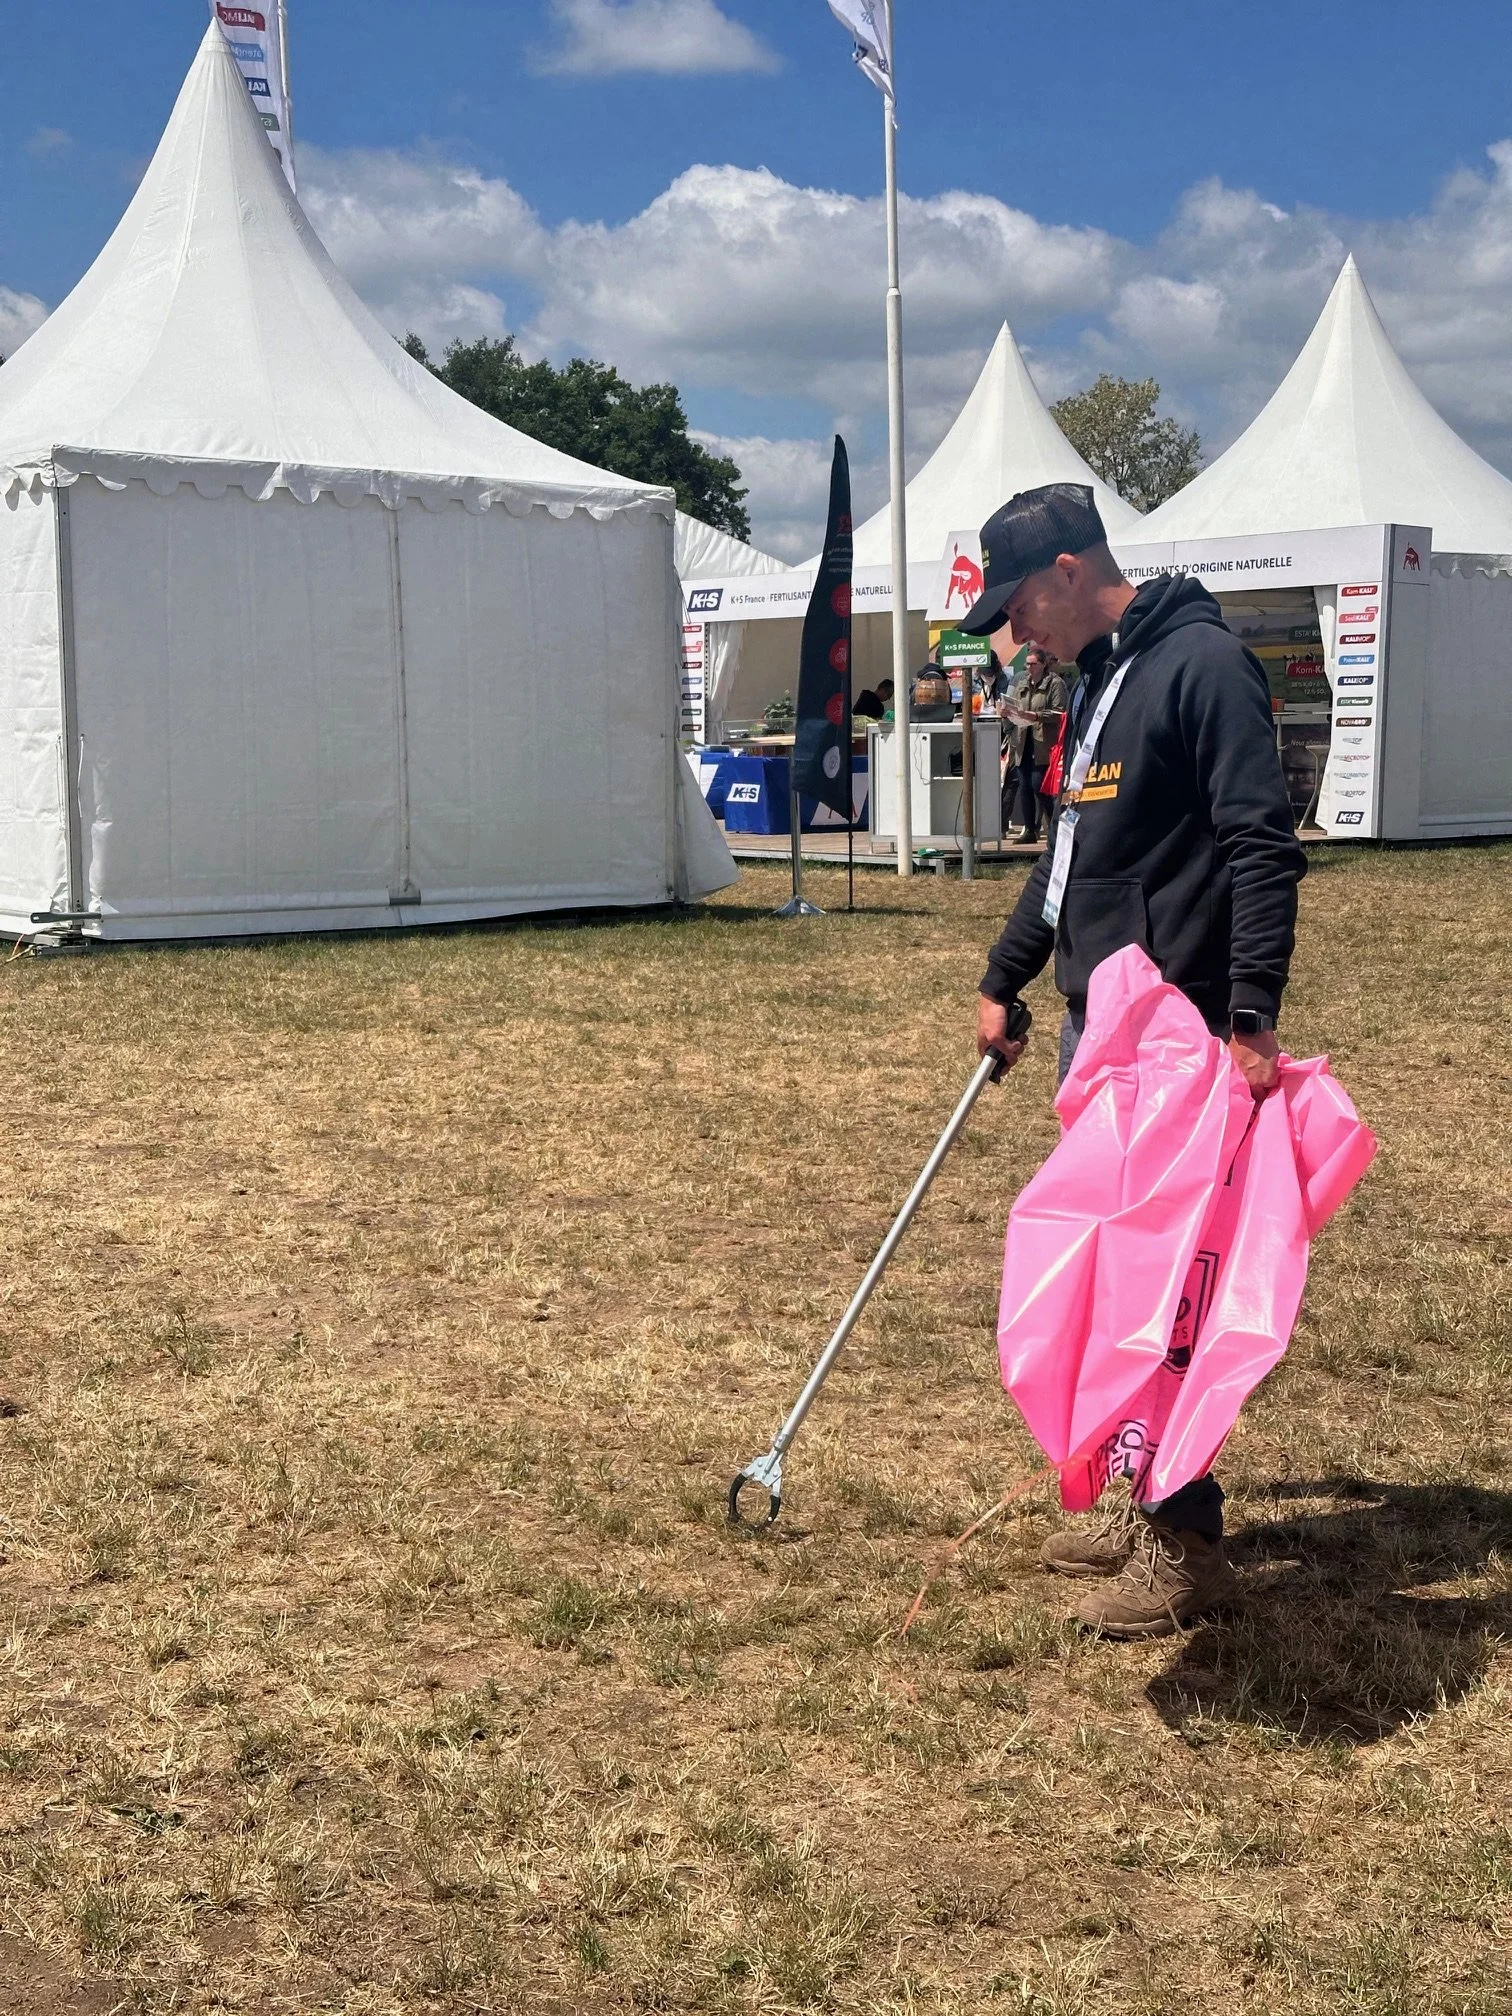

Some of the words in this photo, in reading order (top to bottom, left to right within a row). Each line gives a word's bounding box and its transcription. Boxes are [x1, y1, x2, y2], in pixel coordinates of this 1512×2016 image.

[1182, 560, 1233, 574] D'ORIGINE
[1236, 556, 1293, 571] NATURELLE
[690, 592, 718, 608] K+S
[730, 595, 744, 604] K+S
[744, 594, 766, 604] France
[769, 590, 812, 602] FERTILISANT
[855, 584, 893, 596] NATURELL
[958, 642, 985, 651] FRANCE
[732, 787, 758, 799] K+S
[1337, 812, 1361, 823] K+S
